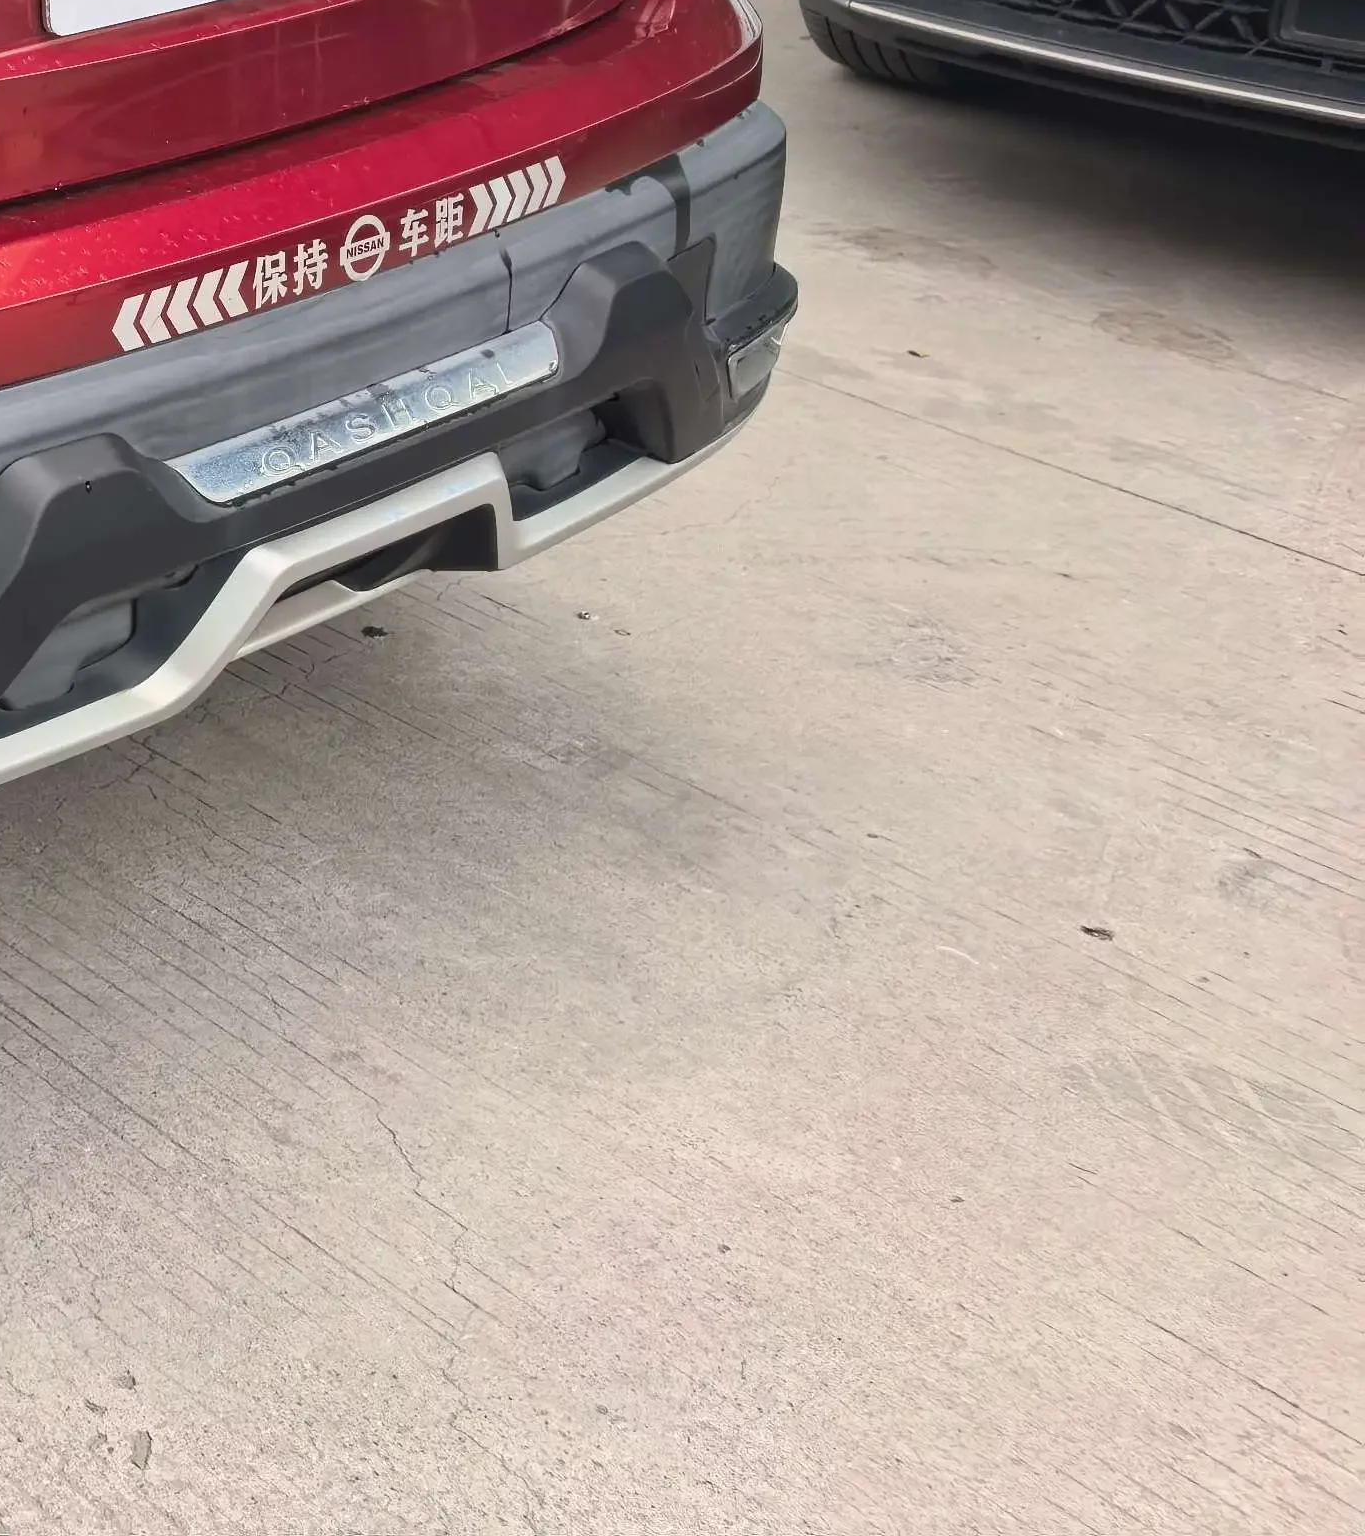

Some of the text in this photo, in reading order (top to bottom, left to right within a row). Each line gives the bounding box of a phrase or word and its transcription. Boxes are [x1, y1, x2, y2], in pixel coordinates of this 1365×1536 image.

[251, 192, 465, 309] 保持 NISSAN 车距
[256, 361, 515, 477] QASHQAI
